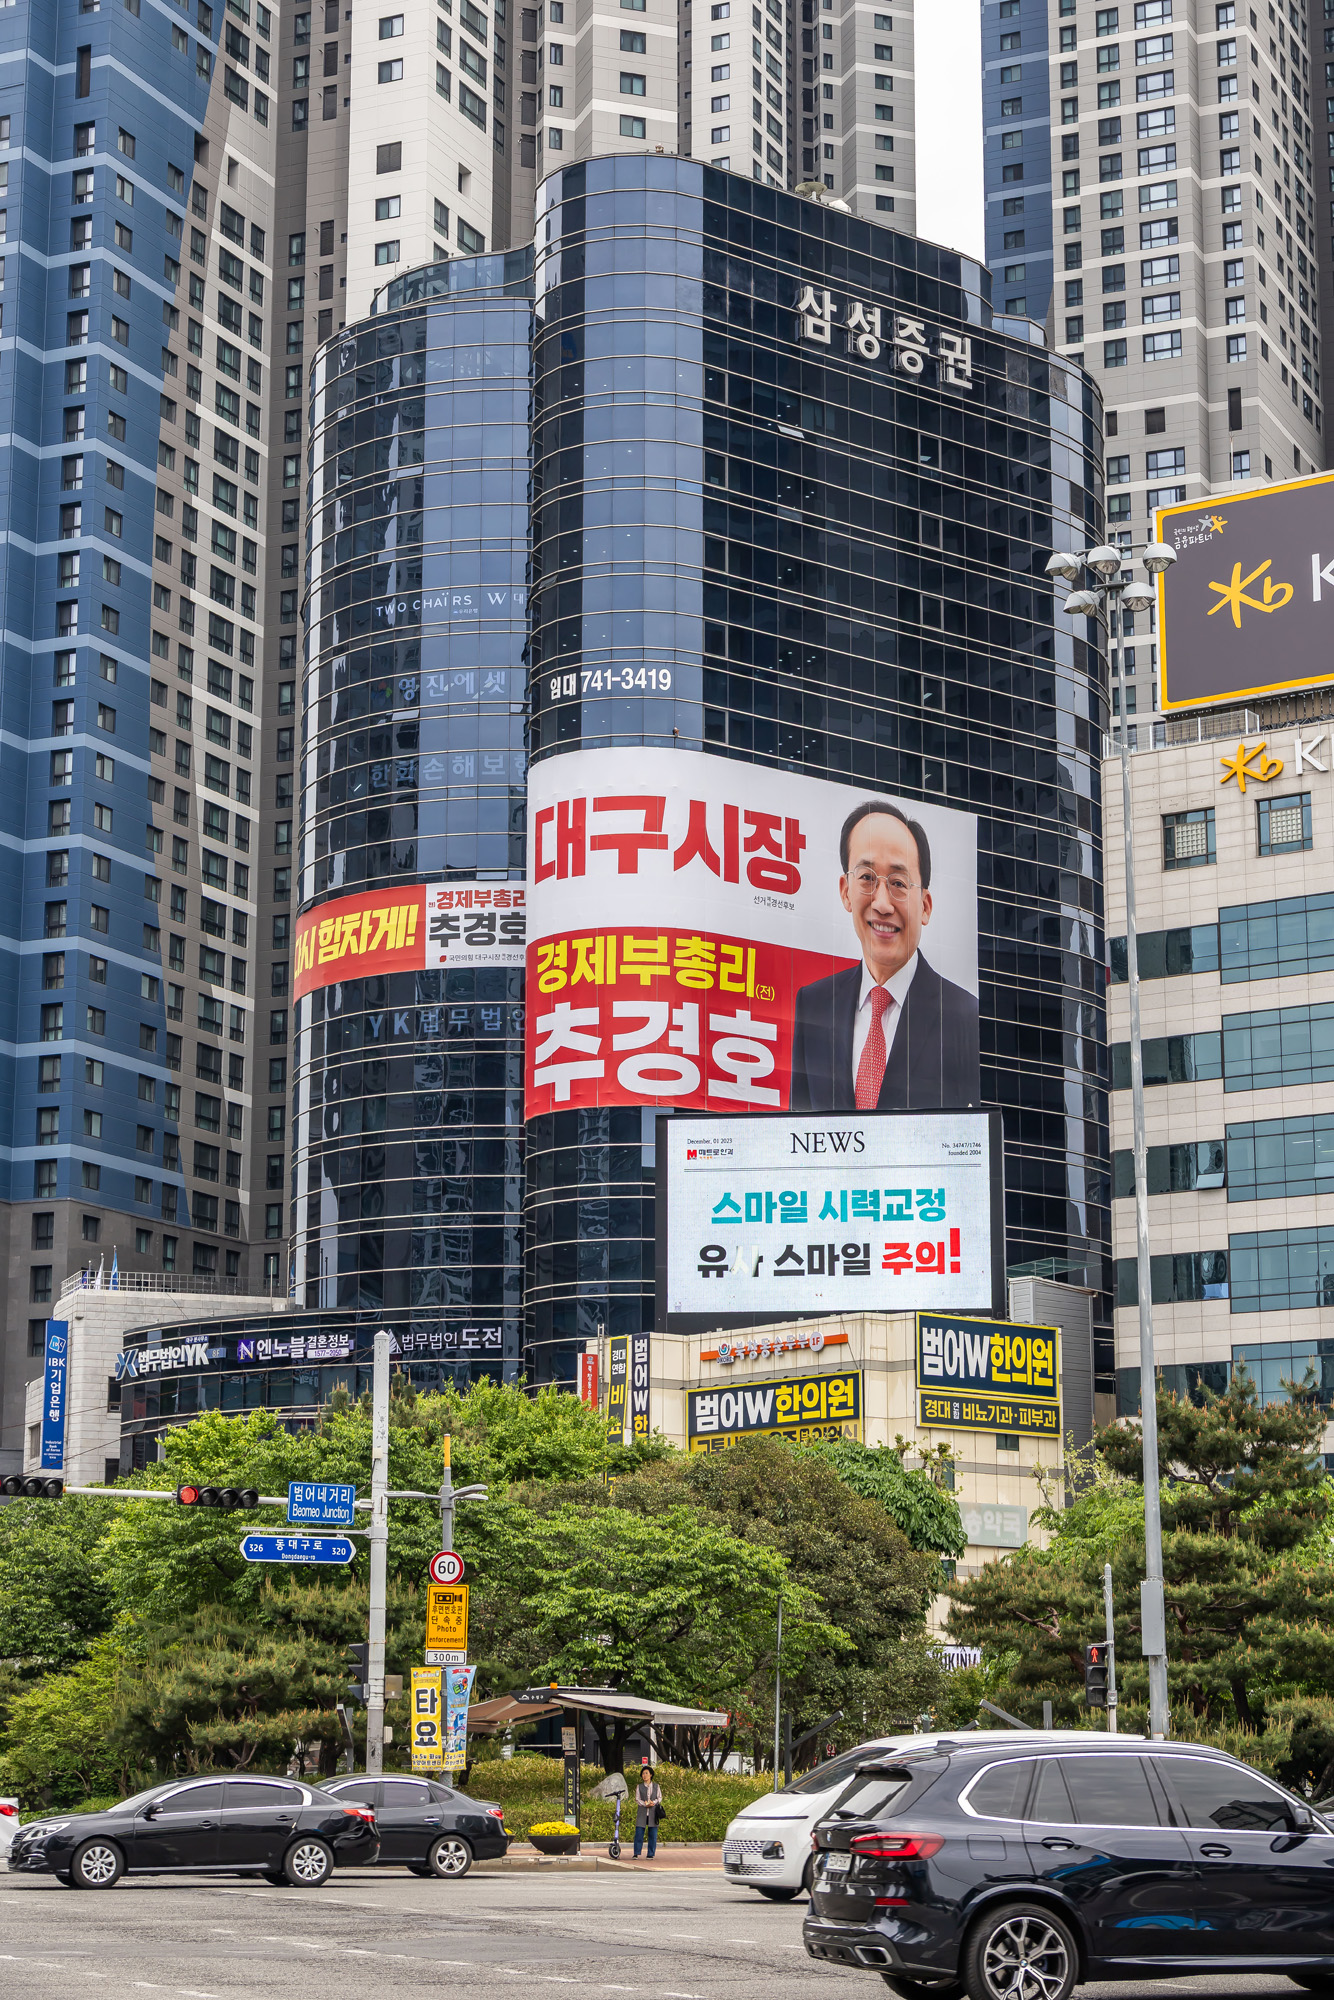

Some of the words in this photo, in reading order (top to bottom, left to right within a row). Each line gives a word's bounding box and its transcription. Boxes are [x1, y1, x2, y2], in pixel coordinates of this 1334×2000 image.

[798, 285, 973, 390] 삼성증권
[1174, 533, 1213, 550] 금융파트너
[376, 603, 407, 617] TWO
[399, 671, 506, 700] 영진에셋
[550, 673, 577, 700] 임대
[580, 667, 672, 693] 741-3419
[534, 795, 807, 895] 대구시장
[318, 904, 419, 965] 힘차게!
[429, 912, 526, 947] 추경호
[537, 936, 757, 998] 경제부총리
[534, 1000, 781, 1106] 추경호
[790, 1131, 866, 1154] NEWS
[711, 1190, 808, 1224] 스마일
[818, 1188, 946, 1222] 시력교정
[774, 1242, 871, 1276] 스마일
[882, 1228, 961, 1275] 주의!
[256, 1337, 306, 1361] 엔노블
[307, 1333, 349, 1349] 결혼정보
[402, 1332, 458, 1351] 법무법인
[460, 1326, 503, 1349] 도전
[734, 1333, 809, 1360] 북창동순두부
[811, 1336, 821, 1346] 1F
[48, 1358, 66, 1367] IBK
[49, 1369, 62, 1422] 기업은행
[924, 1399, 951, 1419] 경대
[294, 1485, 351, 1504] 범어네거리
[292, 1503, 320, 1518] Beomeo
[322, 1505, 350, 1519] Junction
[249, 1543, 264, 1553] 326
[275, 1538, 323, 1551] 동대구로
[331, 1547, 346, 1556] 320
[438, 1560, 456, 1575] 60
[429, 1636, 464, 1644] enforcement
[436, 1625, 457, 1633] Photo
[433, 1653, 459, 1662] 300m
